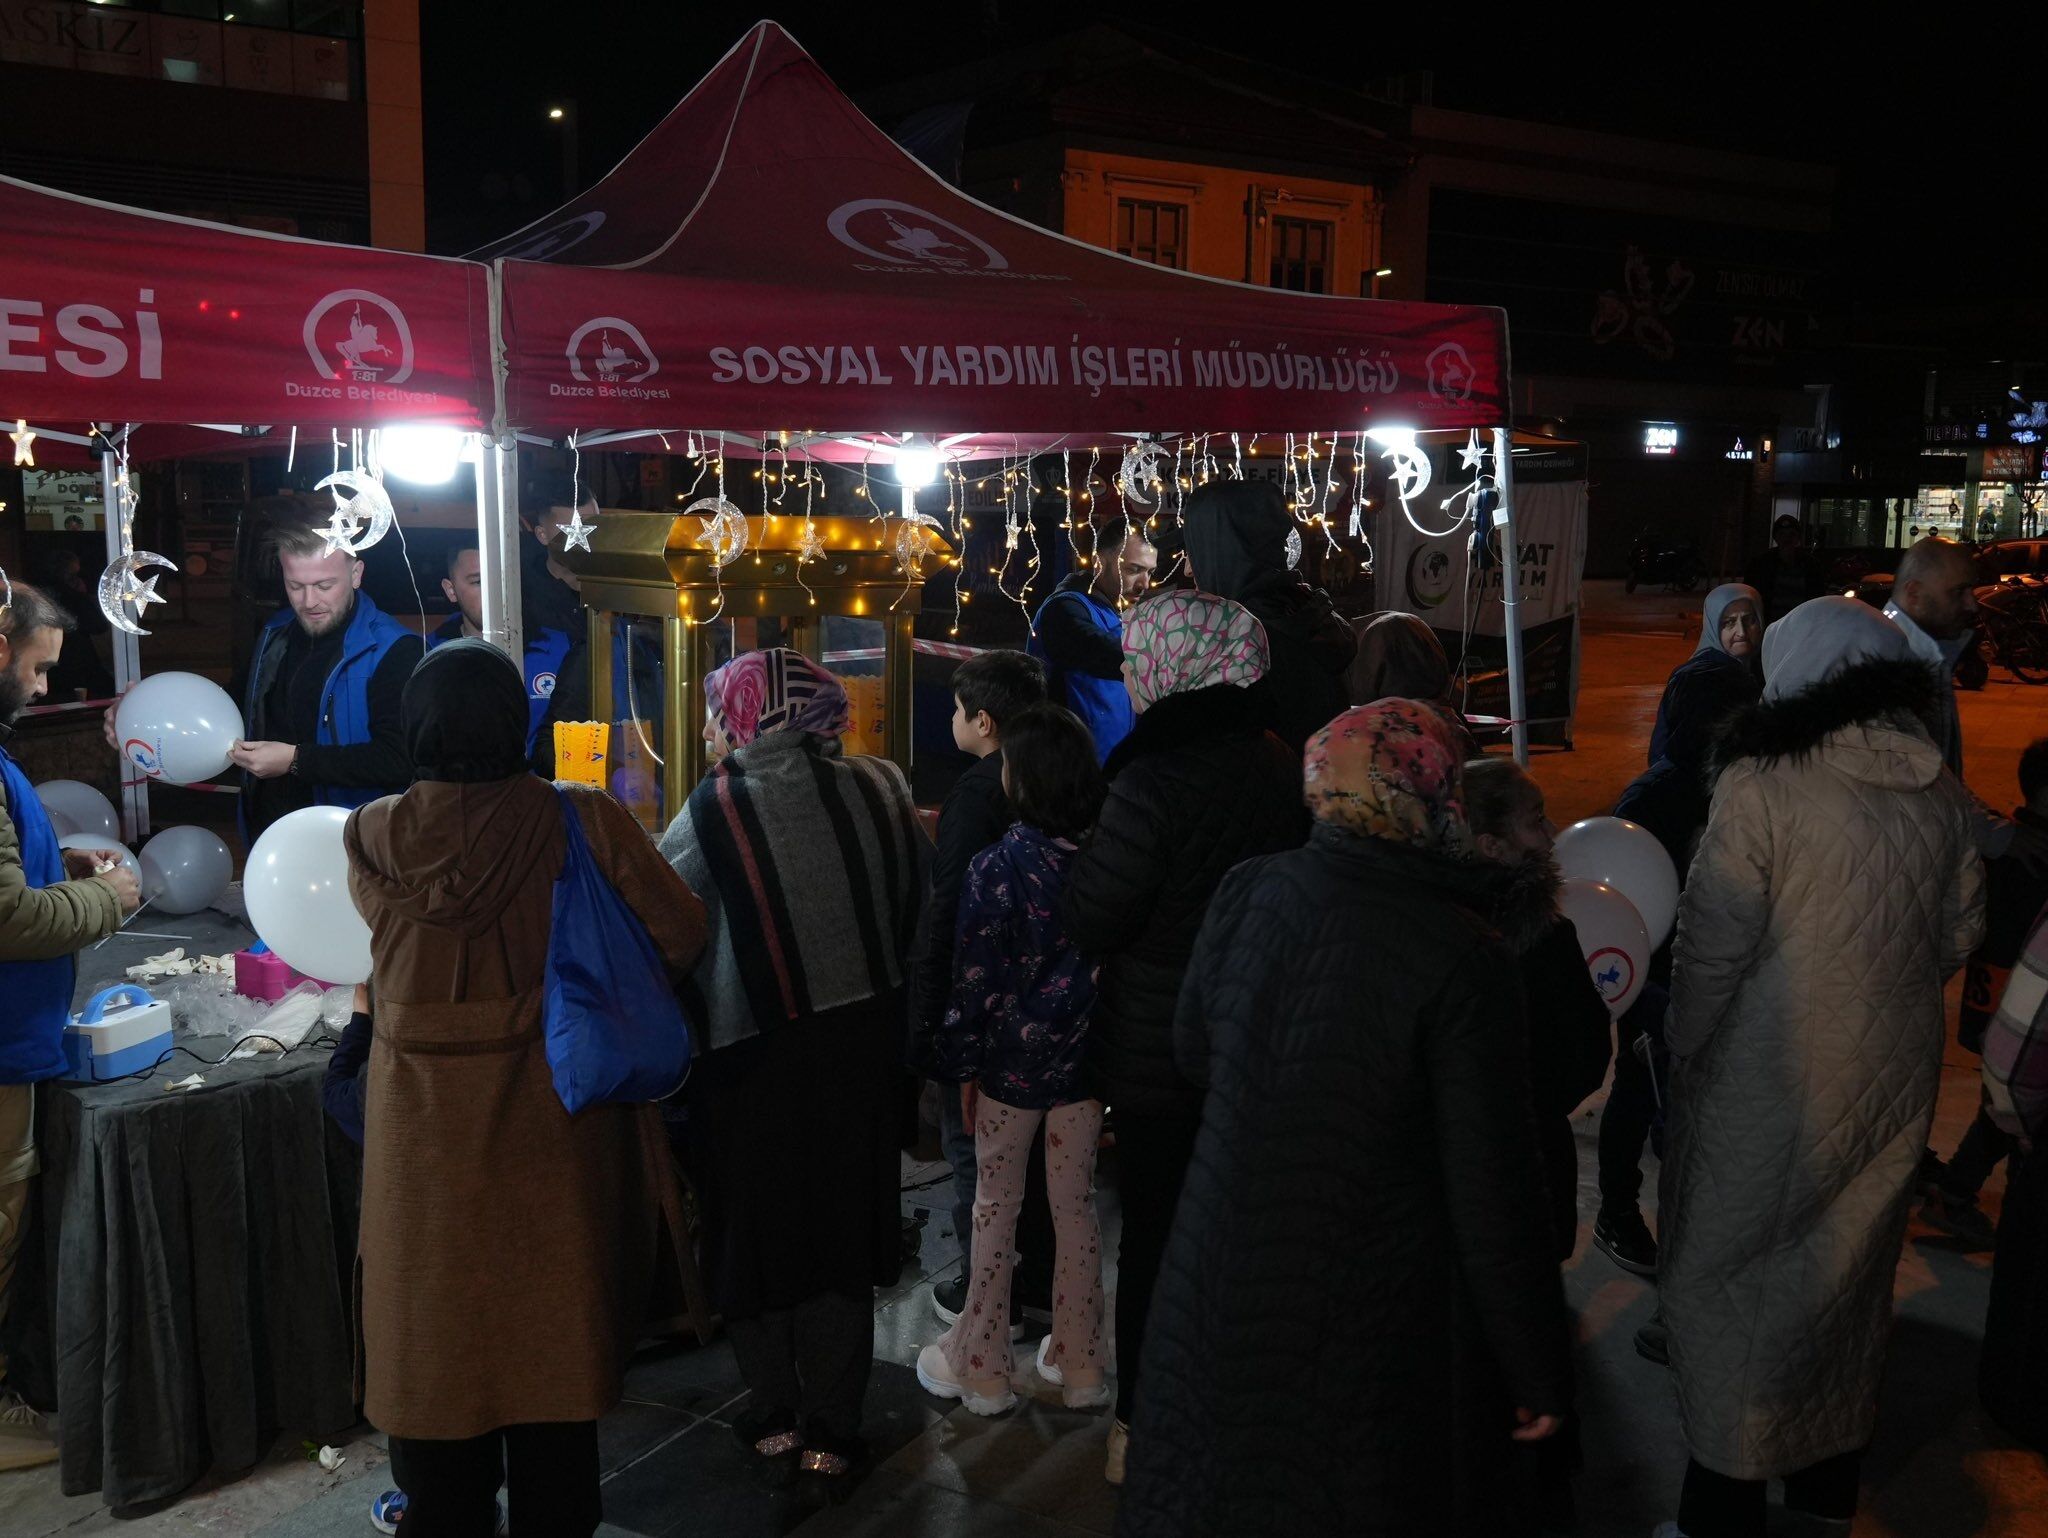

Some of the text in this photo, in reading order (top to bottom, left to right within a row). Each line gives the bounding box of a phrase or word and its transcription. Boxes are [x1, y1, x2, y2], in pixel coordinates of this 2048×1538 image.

[709, 333, 1400, 398] SOSYAL YARDIM İŞLERİ MÜDÜRLÜĞÜ
[285, 382, 438, 405] Düzce Belediyesi
[549, 383, 671, 400] Düzce Belediyesi
[1469, 569, 1546, 588] YARIM
